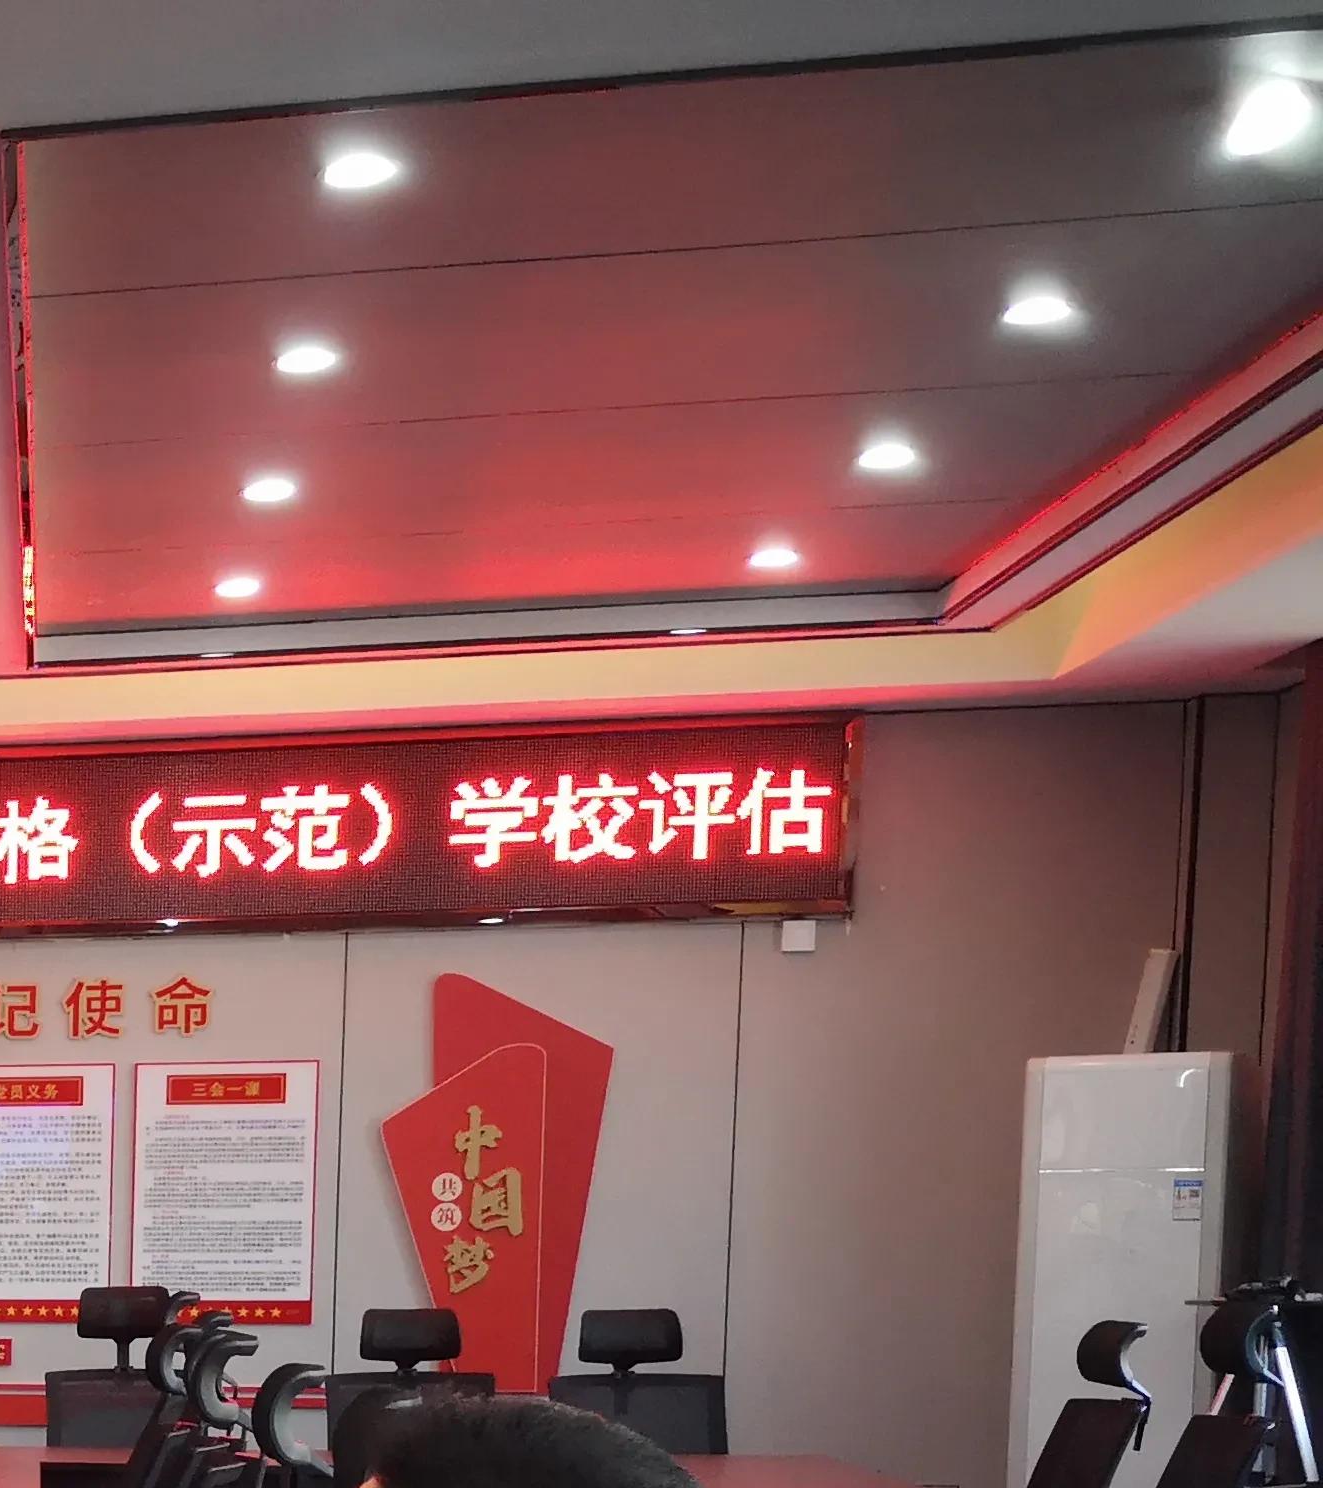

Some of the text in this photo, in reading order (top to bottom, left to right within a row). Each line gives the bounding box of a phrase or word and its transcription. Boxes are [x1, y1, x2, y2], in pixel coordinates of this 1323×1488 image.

[191, 1083, 260, 1097] 三会一课
[443, 1104, 524, 1294] 中国梦
